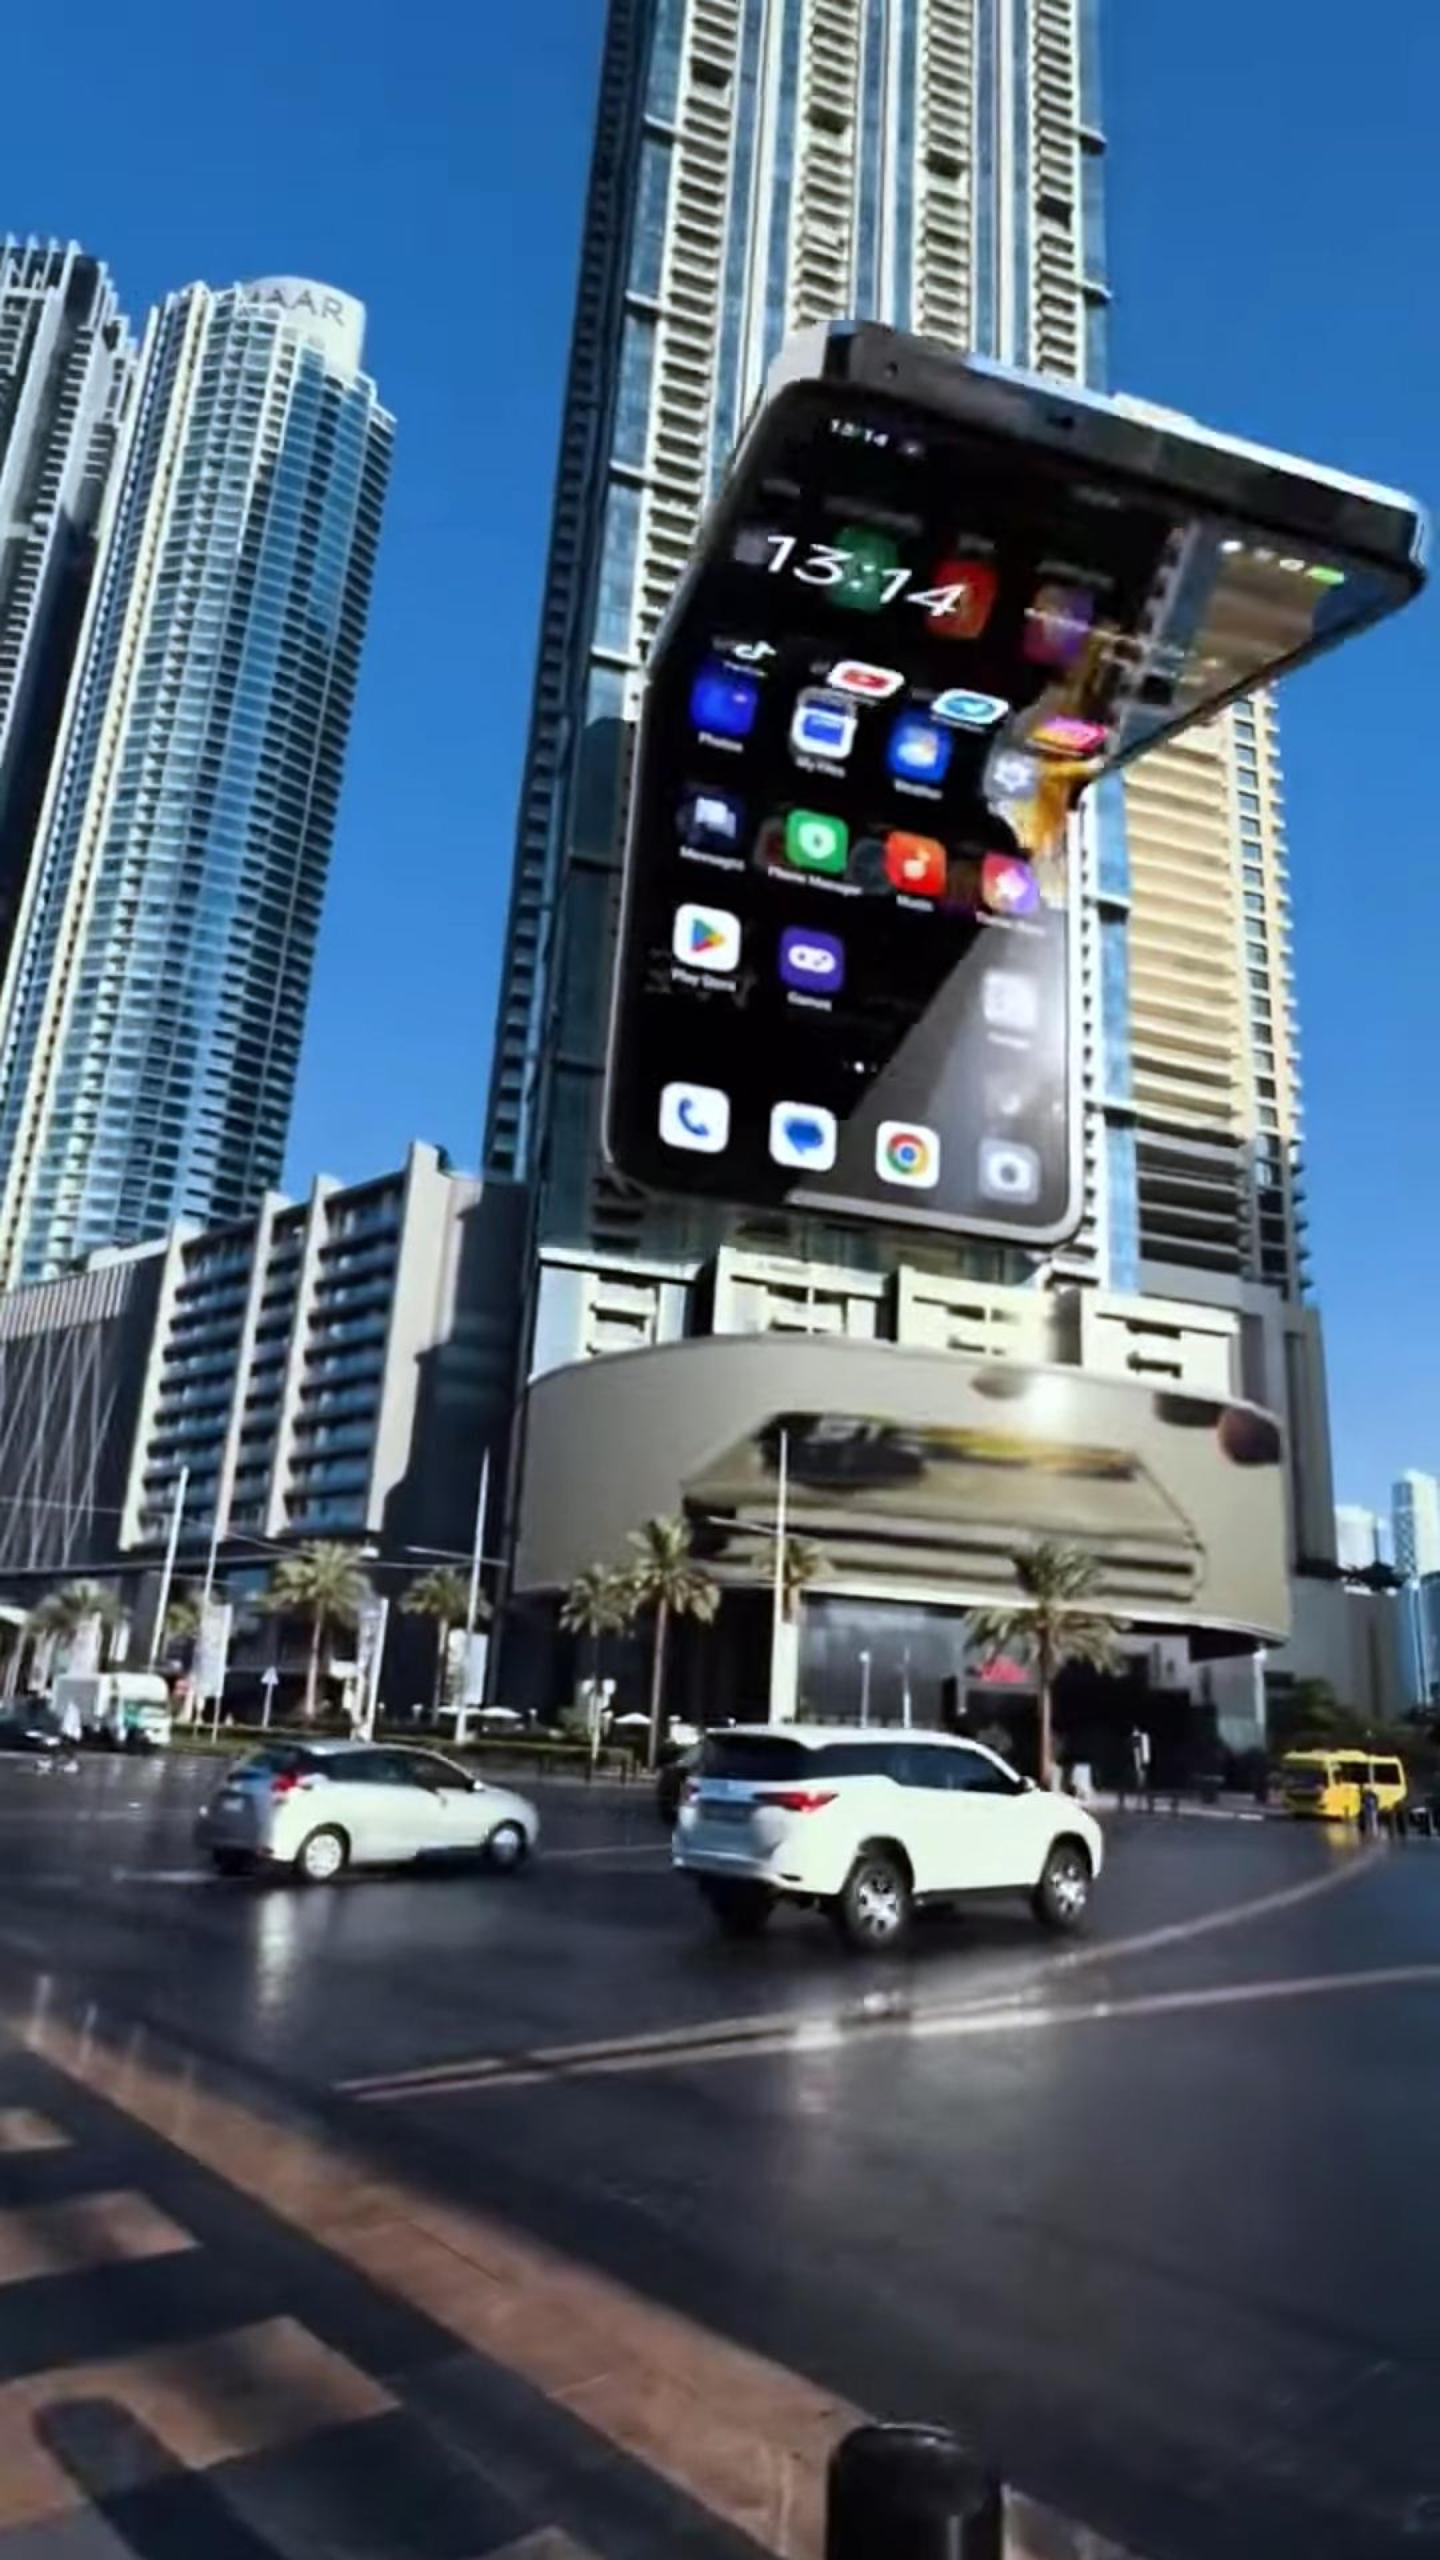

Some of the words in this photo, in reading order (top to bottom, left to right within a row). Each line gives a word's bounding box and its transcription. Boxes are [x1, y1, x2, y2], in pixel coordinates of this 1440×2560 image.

[766, 535, 968, 617] 13:14
[698, 731, 744, 753] Photos
[767, 864, 807, 884] Phone
[671, 967, 699, 987] Play
